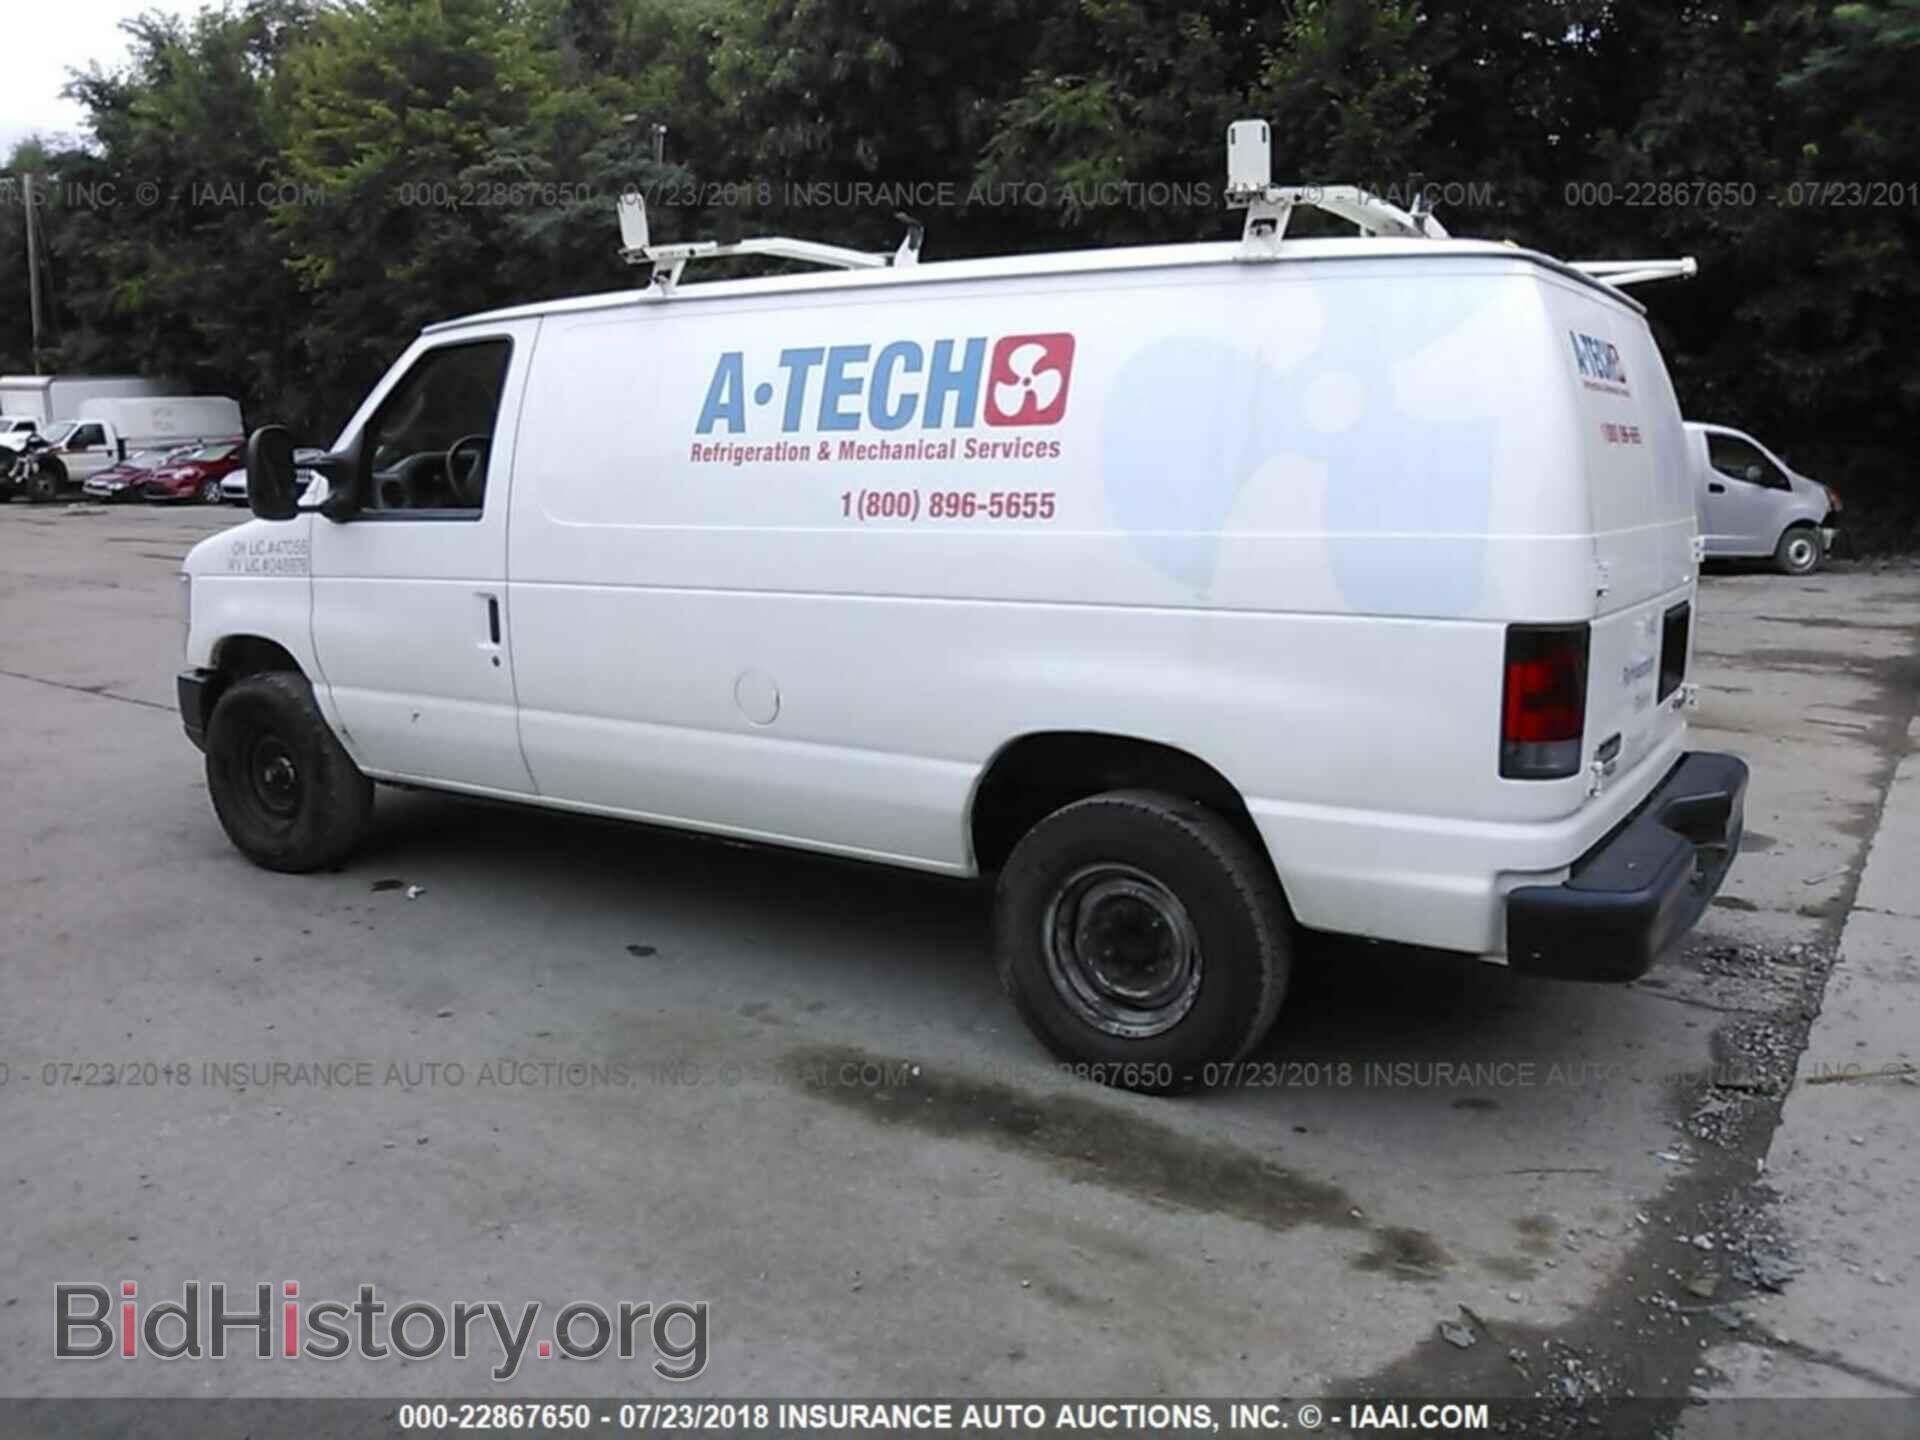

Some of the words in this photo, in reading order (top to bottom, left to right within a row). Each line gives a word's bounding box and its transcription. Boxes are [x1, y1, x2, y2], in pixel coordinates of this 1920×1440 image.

[690, 442, 811, 466] Refrigeration
[817, 441, 832, 461] &
[838, 438, 956, 461] Mechanical
[963, 438, 1062, 460] Services
[929, 491, 1056, 518] 896-5655
